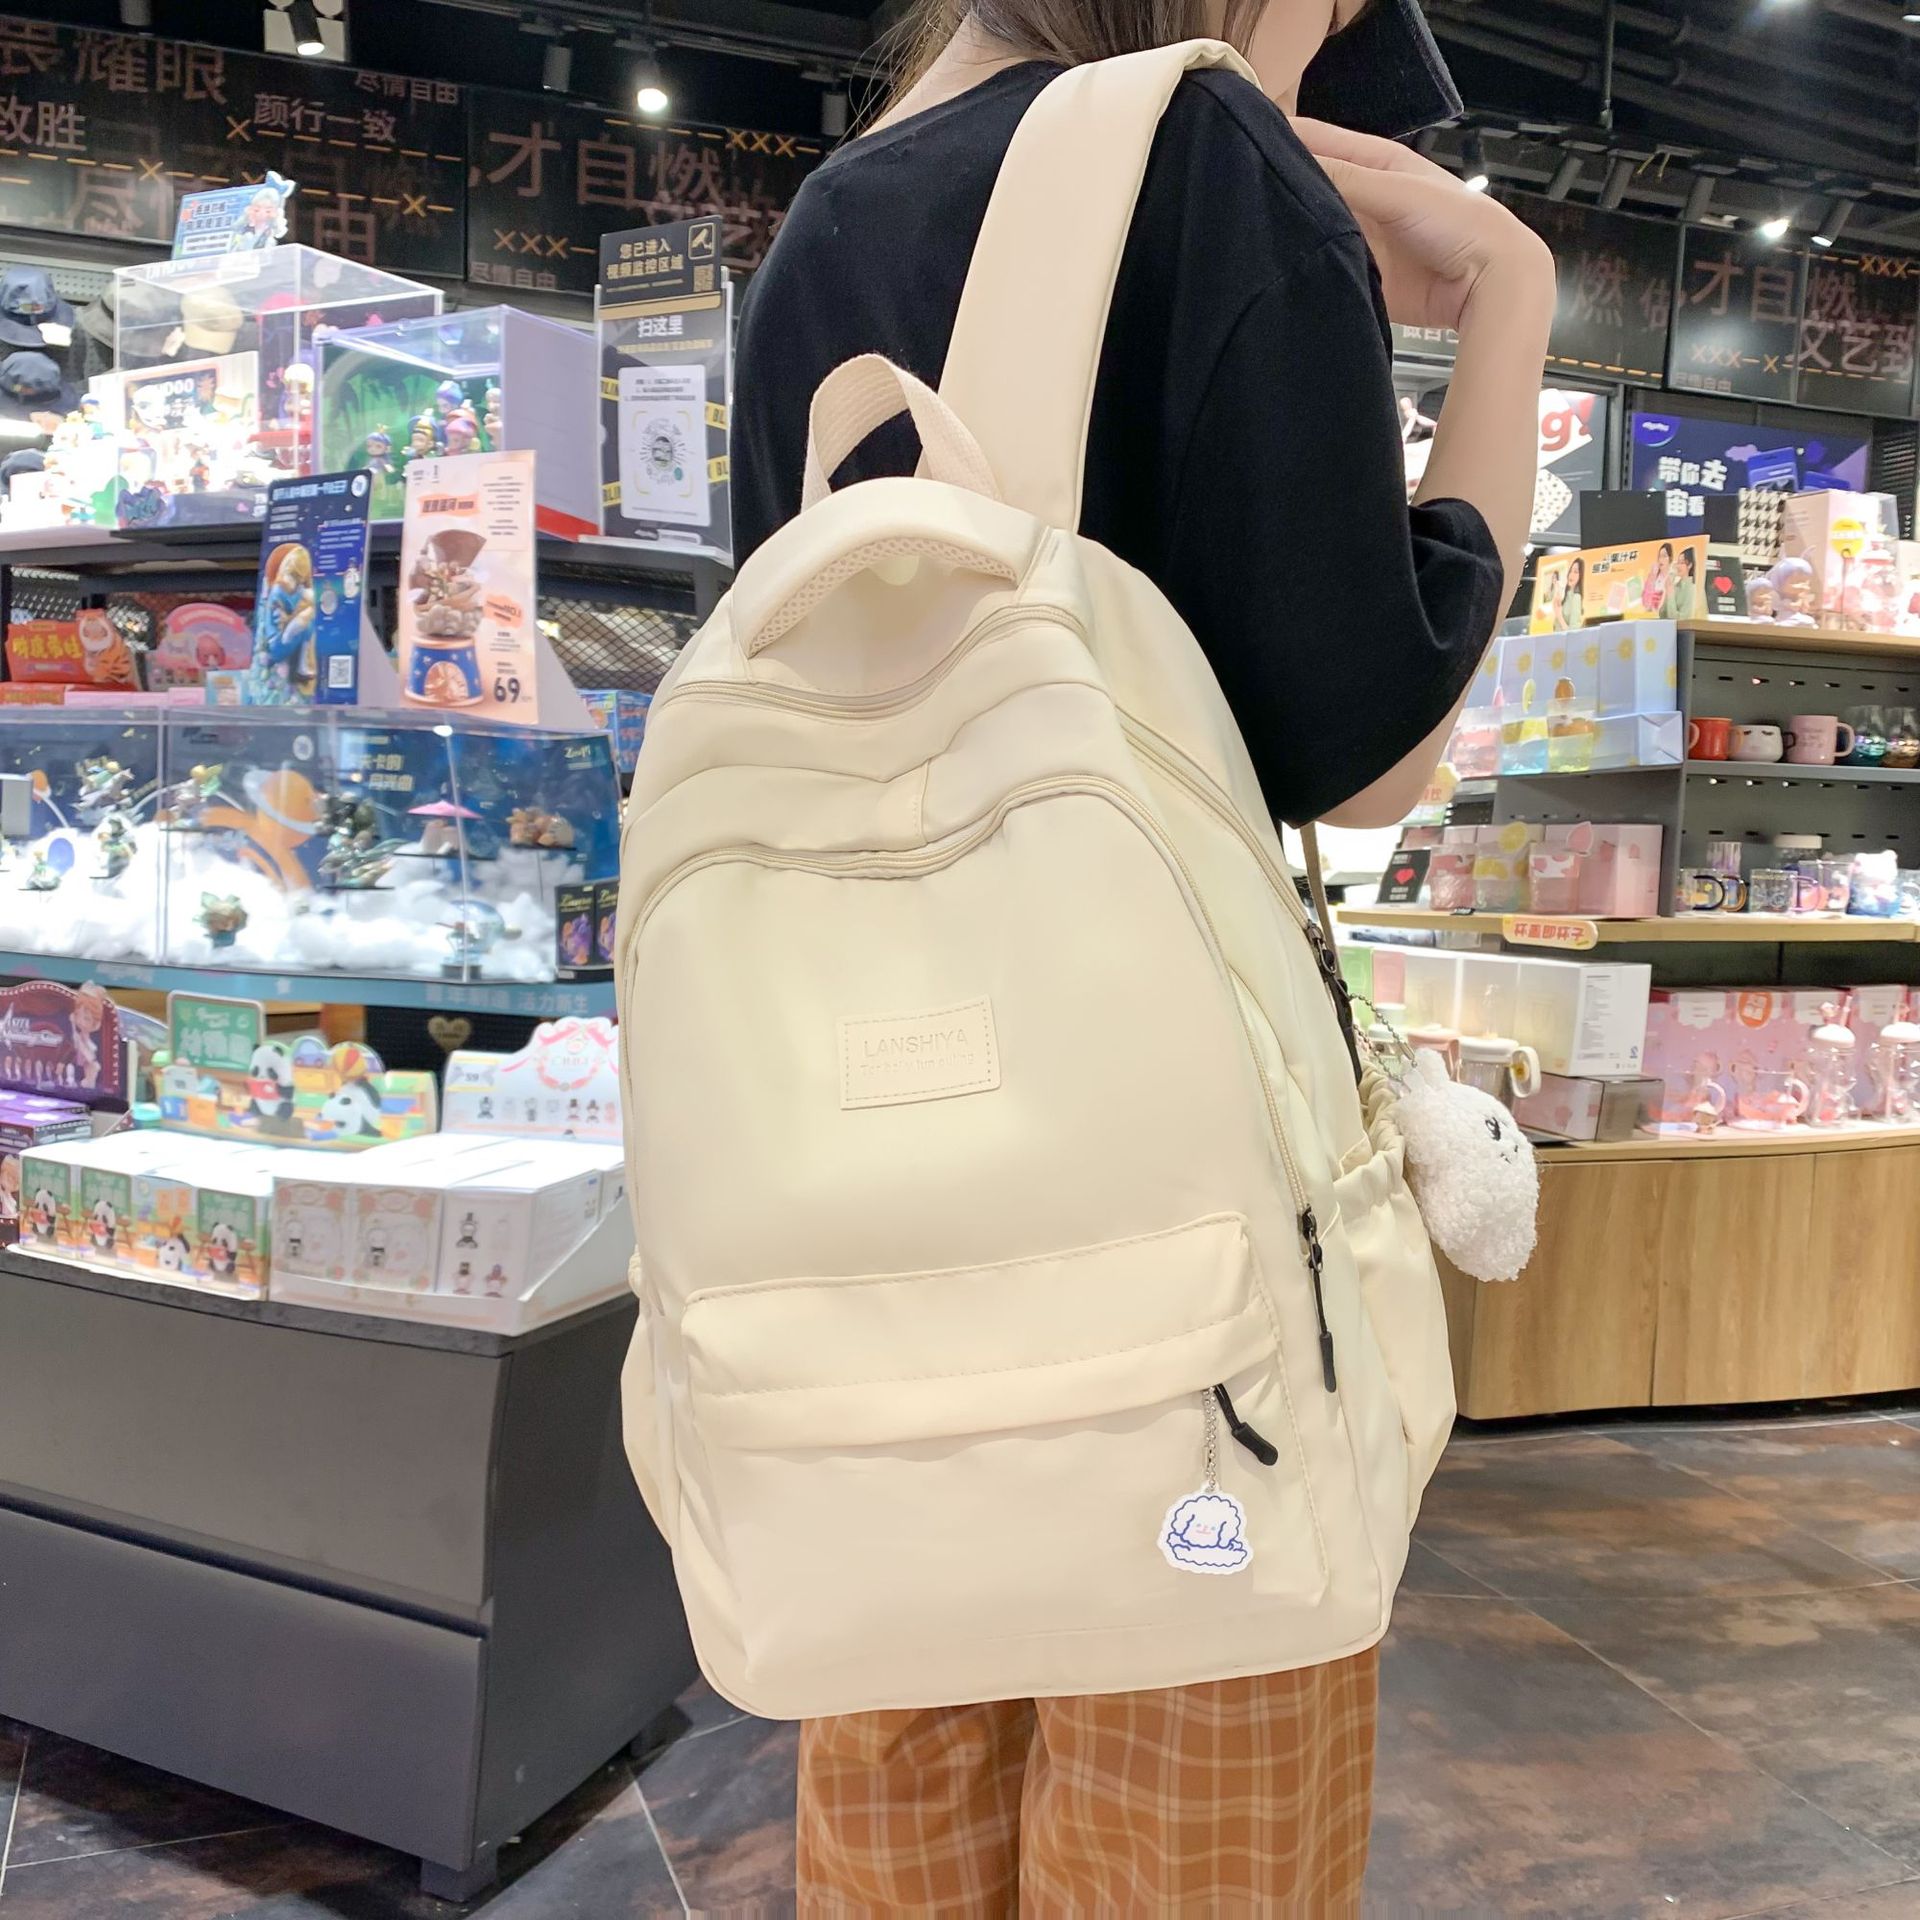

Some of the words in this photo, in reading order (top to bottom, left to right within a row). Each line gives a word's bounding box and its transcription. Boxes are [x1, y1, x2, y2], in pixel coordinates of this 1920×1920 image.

[253, 92, 397, 143] 颜行一致
[1658, 455, 1728, 491] 带你去
[494, 678, 520, 703] 69
[863, 1028, 969, 1058] LANSHIYA
